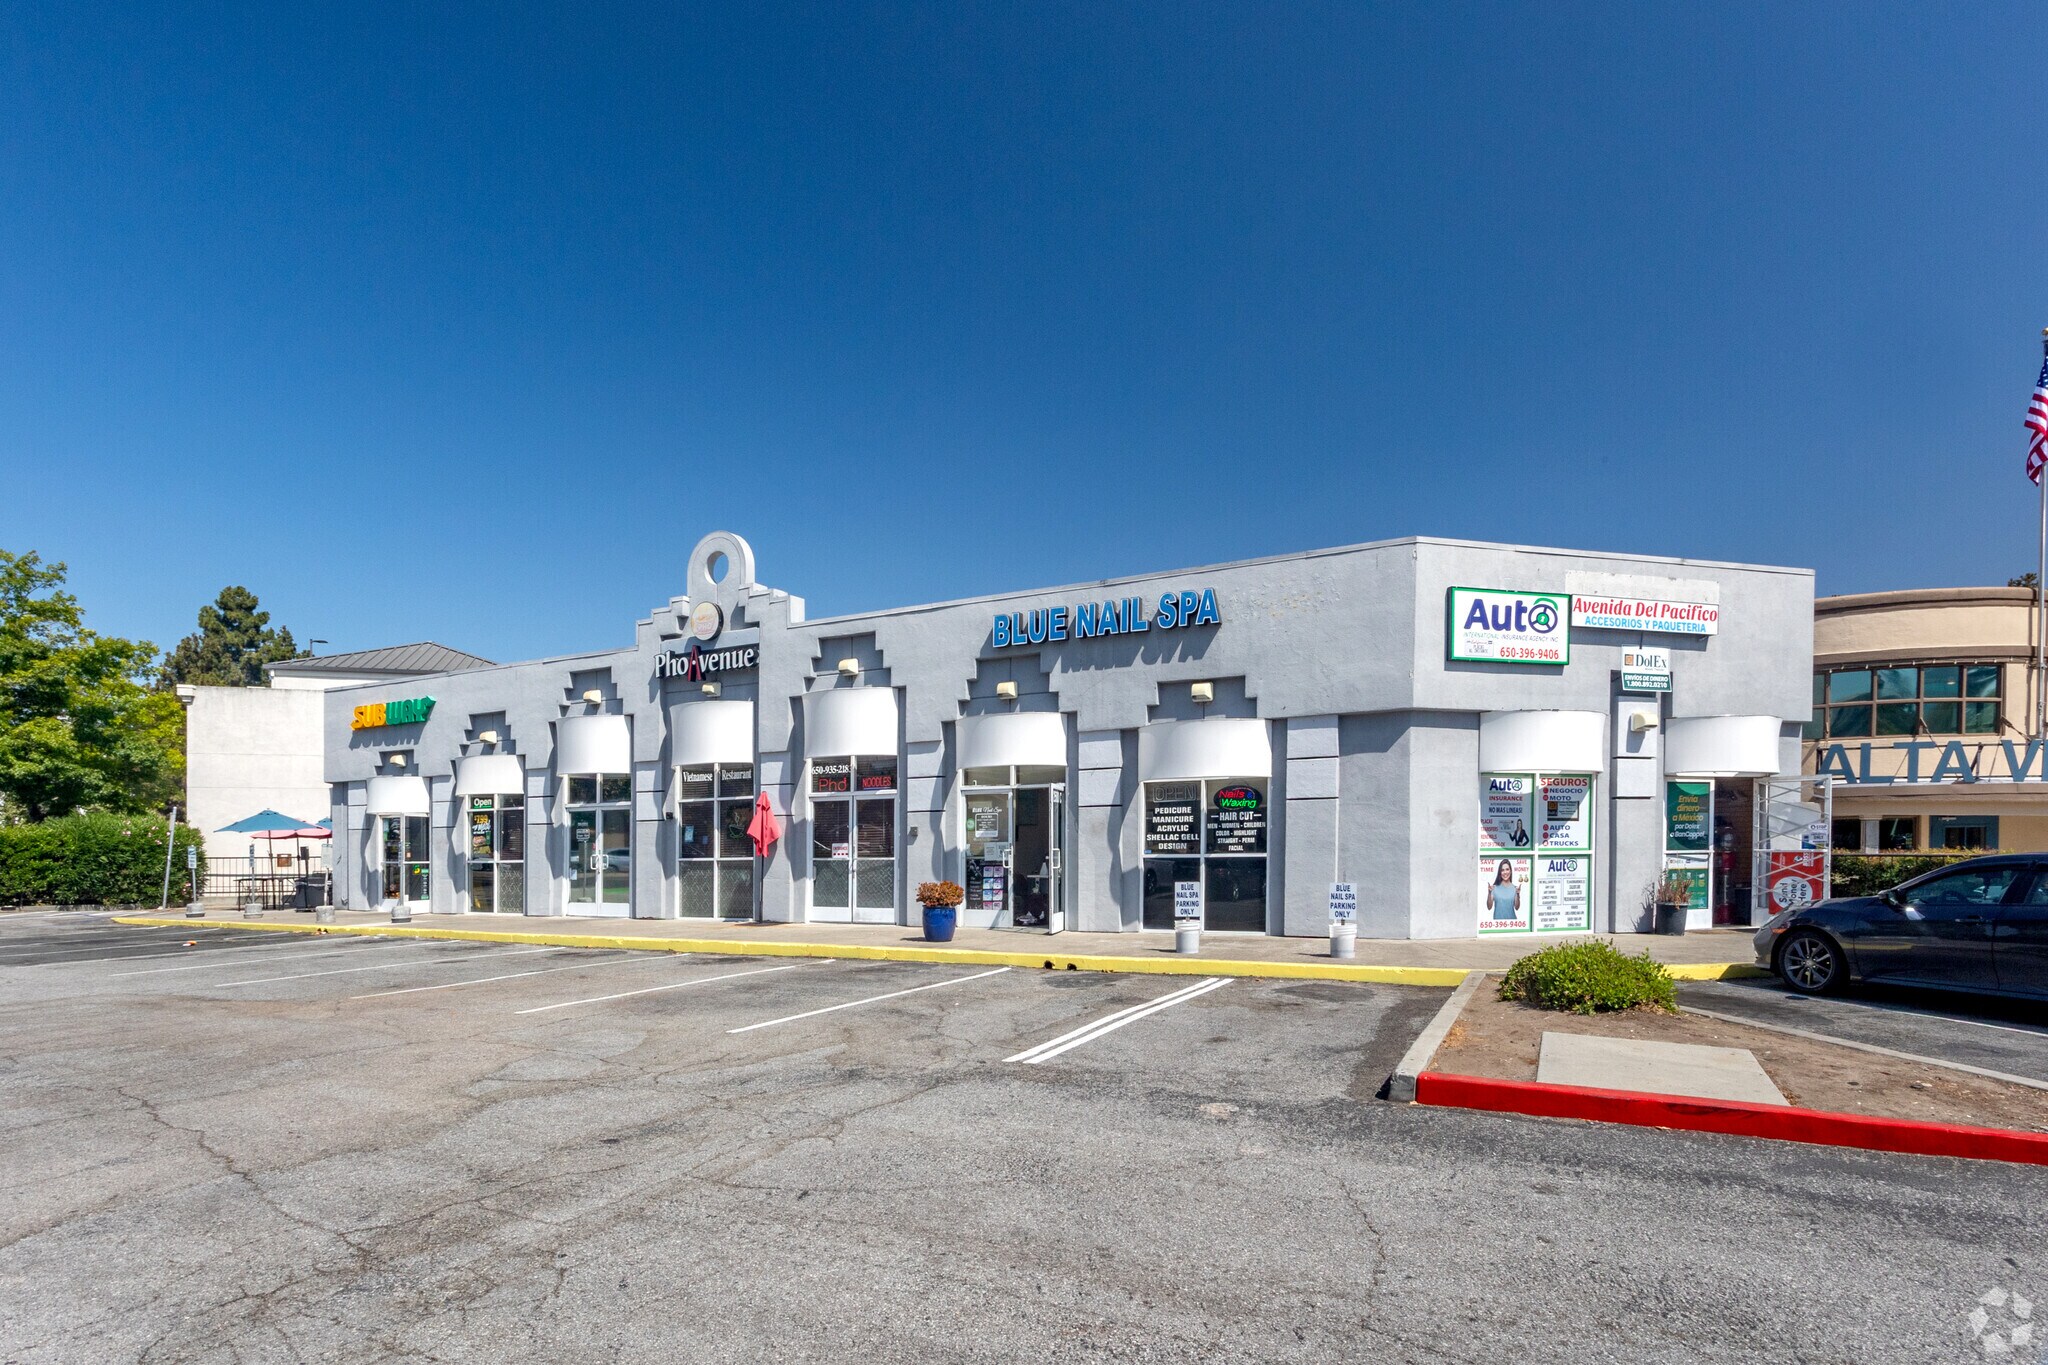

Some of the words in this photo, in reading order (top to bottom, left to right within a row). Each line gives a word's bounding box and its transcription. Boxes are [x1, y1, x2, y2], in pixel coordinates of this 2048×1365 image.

[1573, 597, 1631, 616] Avenida
[1635, 601, 1657, 617] Del
[1661, 603, 1718, 622] Pacifico
[993, 605, 1068, 648] BLUE
[1075, 596, 1150, 639] NAIL
[1157, 588, 1220, 629] SPA
[1463, 598, 1558, 634] Auto
[1585, 615, 1642, 628] ACCESORIOS
[1644, 619, 1651, 628] Y
[1652, 620, 1706, 632] PAQUETERIA
[1502, 634, 1528, 642] INSURANCE
[1500, 647, 1559, 659] 650-396-9406
[1636, 654, 1667, 668] DolEx
[350, 695, 436, 731] SUBWAY
[1814, 740, 1975, 784] ALTA
[683, 771, 713, 782] Vietnamese
[722, 769, 752, 781] Restaurant
[862, 776, 892, 788] NOODLES
[1489, 779, 1523, 791] Auto
[1540, 778, 1588, 786] SEGUROS
[1155, 784, 1193, 800] OPEN
[1218, 790, 1245, 799] Nails
[474, 798, 492, 808] Open
[1221, 798, 1257, 809] Waxing
[1677, 804, 1700, 812] dinero
[1219, 812, 1237, 821] HAIR
[1239, 811, 1254, 820] CUT
[1157, 824, 1189, 832] ACRYLIC
[1336, 884, 1351, 892] BLUE
[1330, 902, 1356, 910] PARKING
